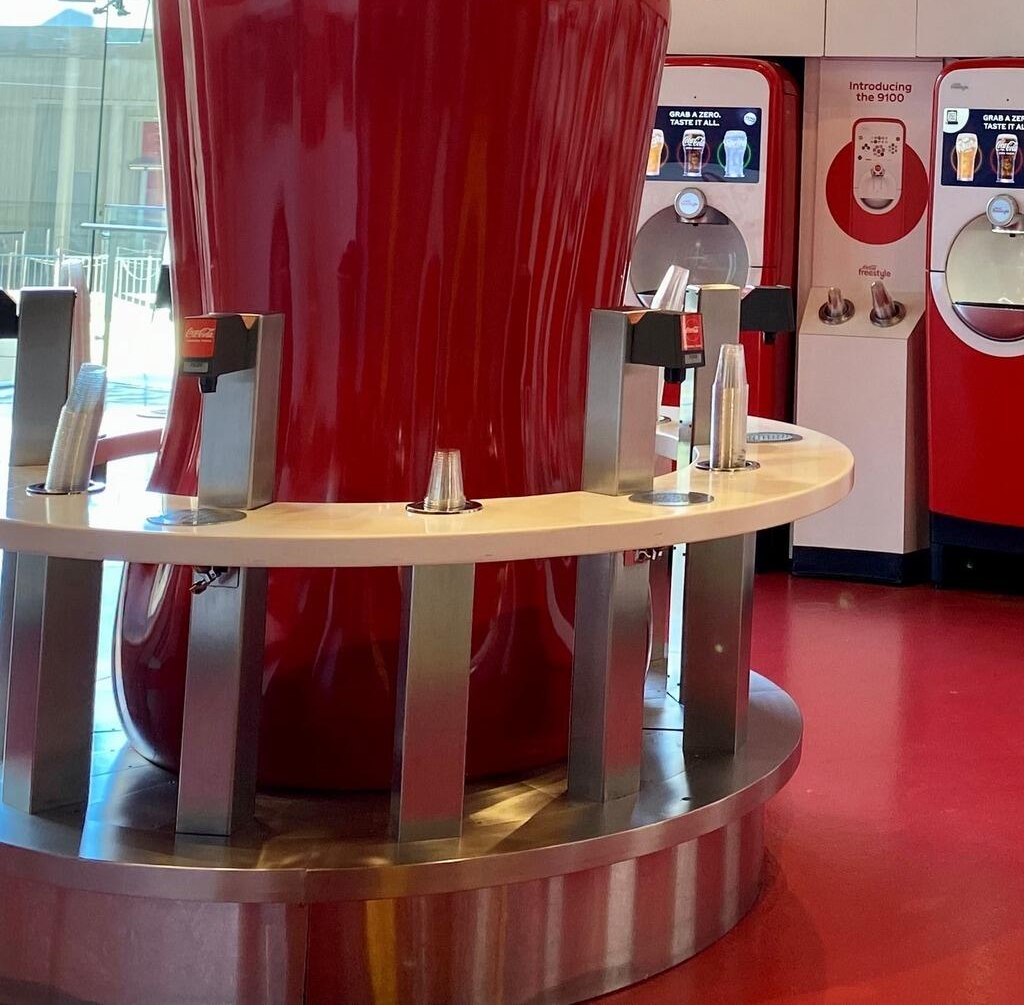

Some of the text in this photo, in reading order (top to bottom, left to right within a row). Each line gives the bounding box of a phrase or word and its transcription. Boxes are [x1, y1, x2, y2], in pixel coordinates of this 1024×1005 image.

[849, 81, 912, 93] Introducing
[856, 93, 905, 103] the 9100
[669, 110, 690, 118] GRAB
[983, 122, 1006, 130] TASTE
[858, 268, 891, 280] freestyle
